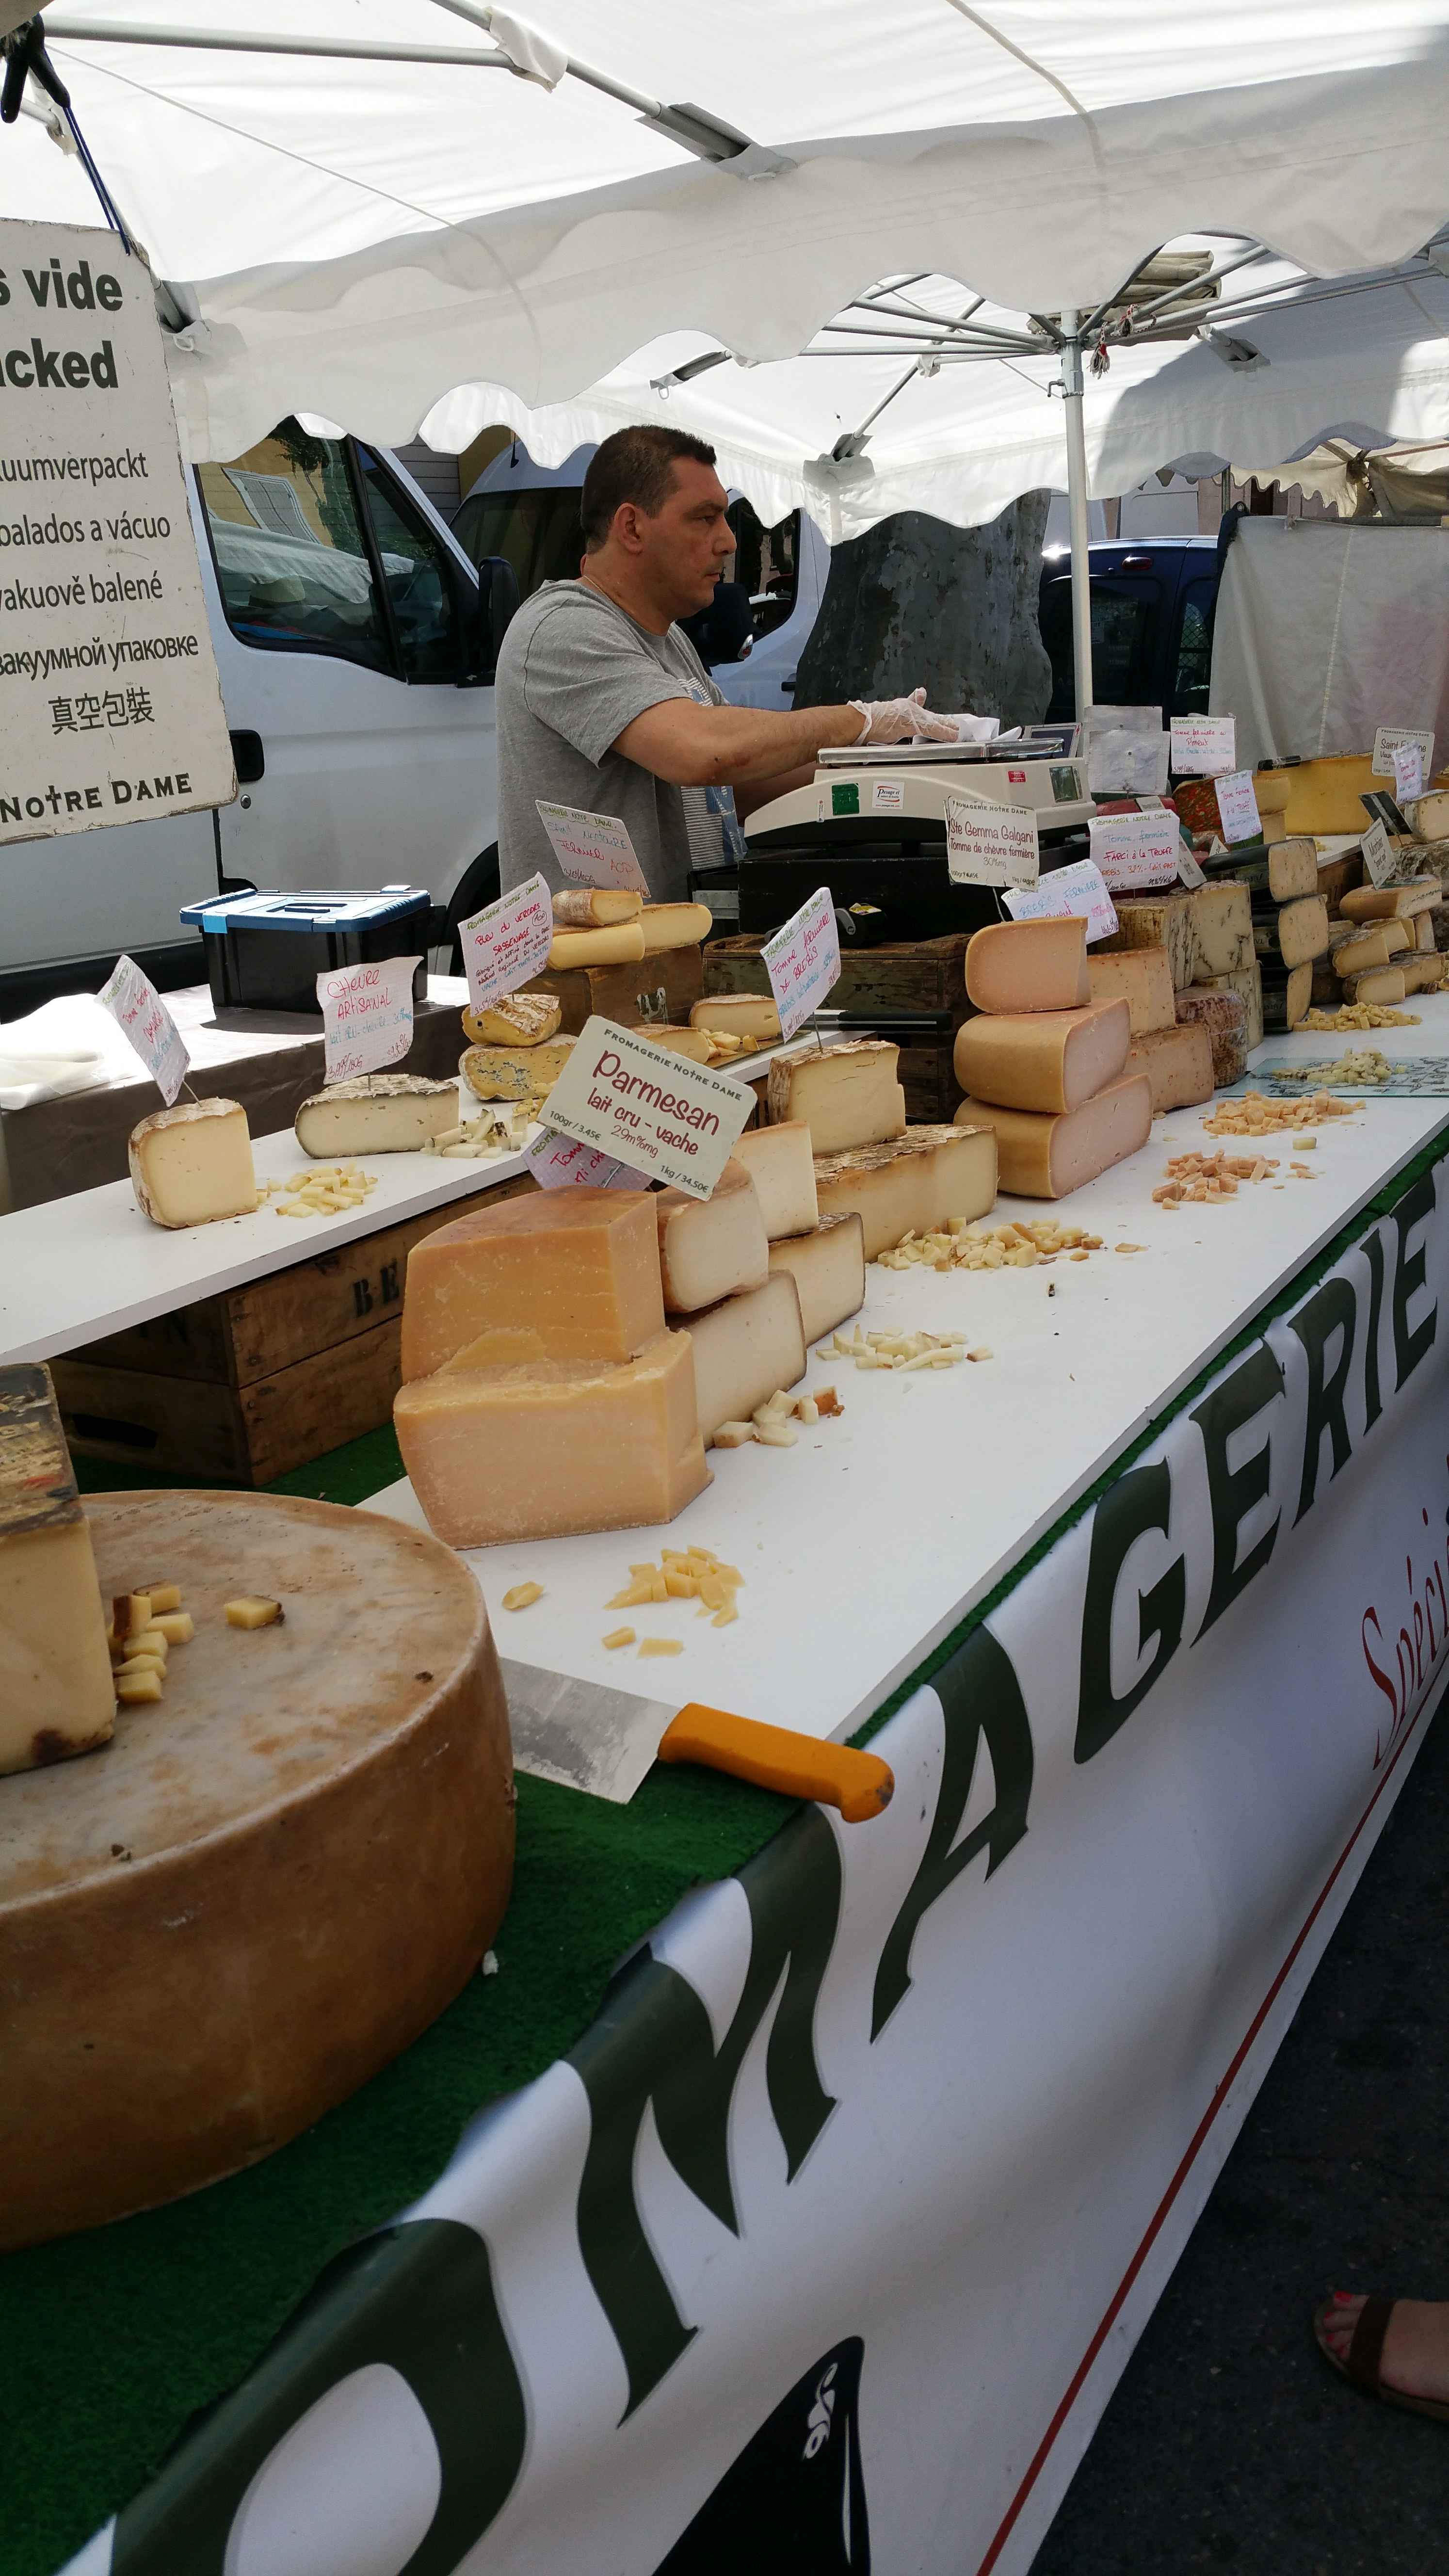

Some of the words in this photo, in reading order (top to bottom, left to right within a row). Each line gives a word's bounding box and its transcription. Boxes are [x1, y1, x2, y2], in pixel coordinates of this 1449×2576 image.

[22, 258, 123, 311] vide
[0, 338, 119, 388] cked
[0, 448, 148, 486] uumverpackt
[92, 523, 103, 541] a
[107, 511, 170, 540] vácuo
[89, 570, 163, 604] balené
[109, 634, 198, 672] упаковке
[48, 686, 155, 735] 真空包裝
[1381, 739, 1399, 750] Saint
[952, 801, 988, 811] FROMAGERIE
[950, 818, 963, 835] Ste
[965, 821, 999, 839] Gemma
[1001, 825, 1033, 846] Galgani
[950, 838, 971, 852] Tomme
[973, 842, 982, 853] de
[984, 842, 1007, 856] chèvre
[1009, 845, 1035, 859] fermière
[515, 902, 541, 923] VERCORS
[493, 927, 530, 956] SASSENAGE
[604, 1029, 671, 1067] FROMAGERIE
[712, 1081, 742, 1101] DAME
[592, 1050, 720, 1136] Parmesan
[549, 1110, 573, 1130] 100gr
[578, 1124, 602, 1141] 3.45€
[587, 1088, 612, 1113] lait
[614, 1106, 641, 1127] cru
[656, 1125, 699, 1156] vache
[660, 1164, 675, 1179] 1kg
[681, 1174, 709, 1193] 34.50€
[1363, 1506, 1449, 1770] Spéci
